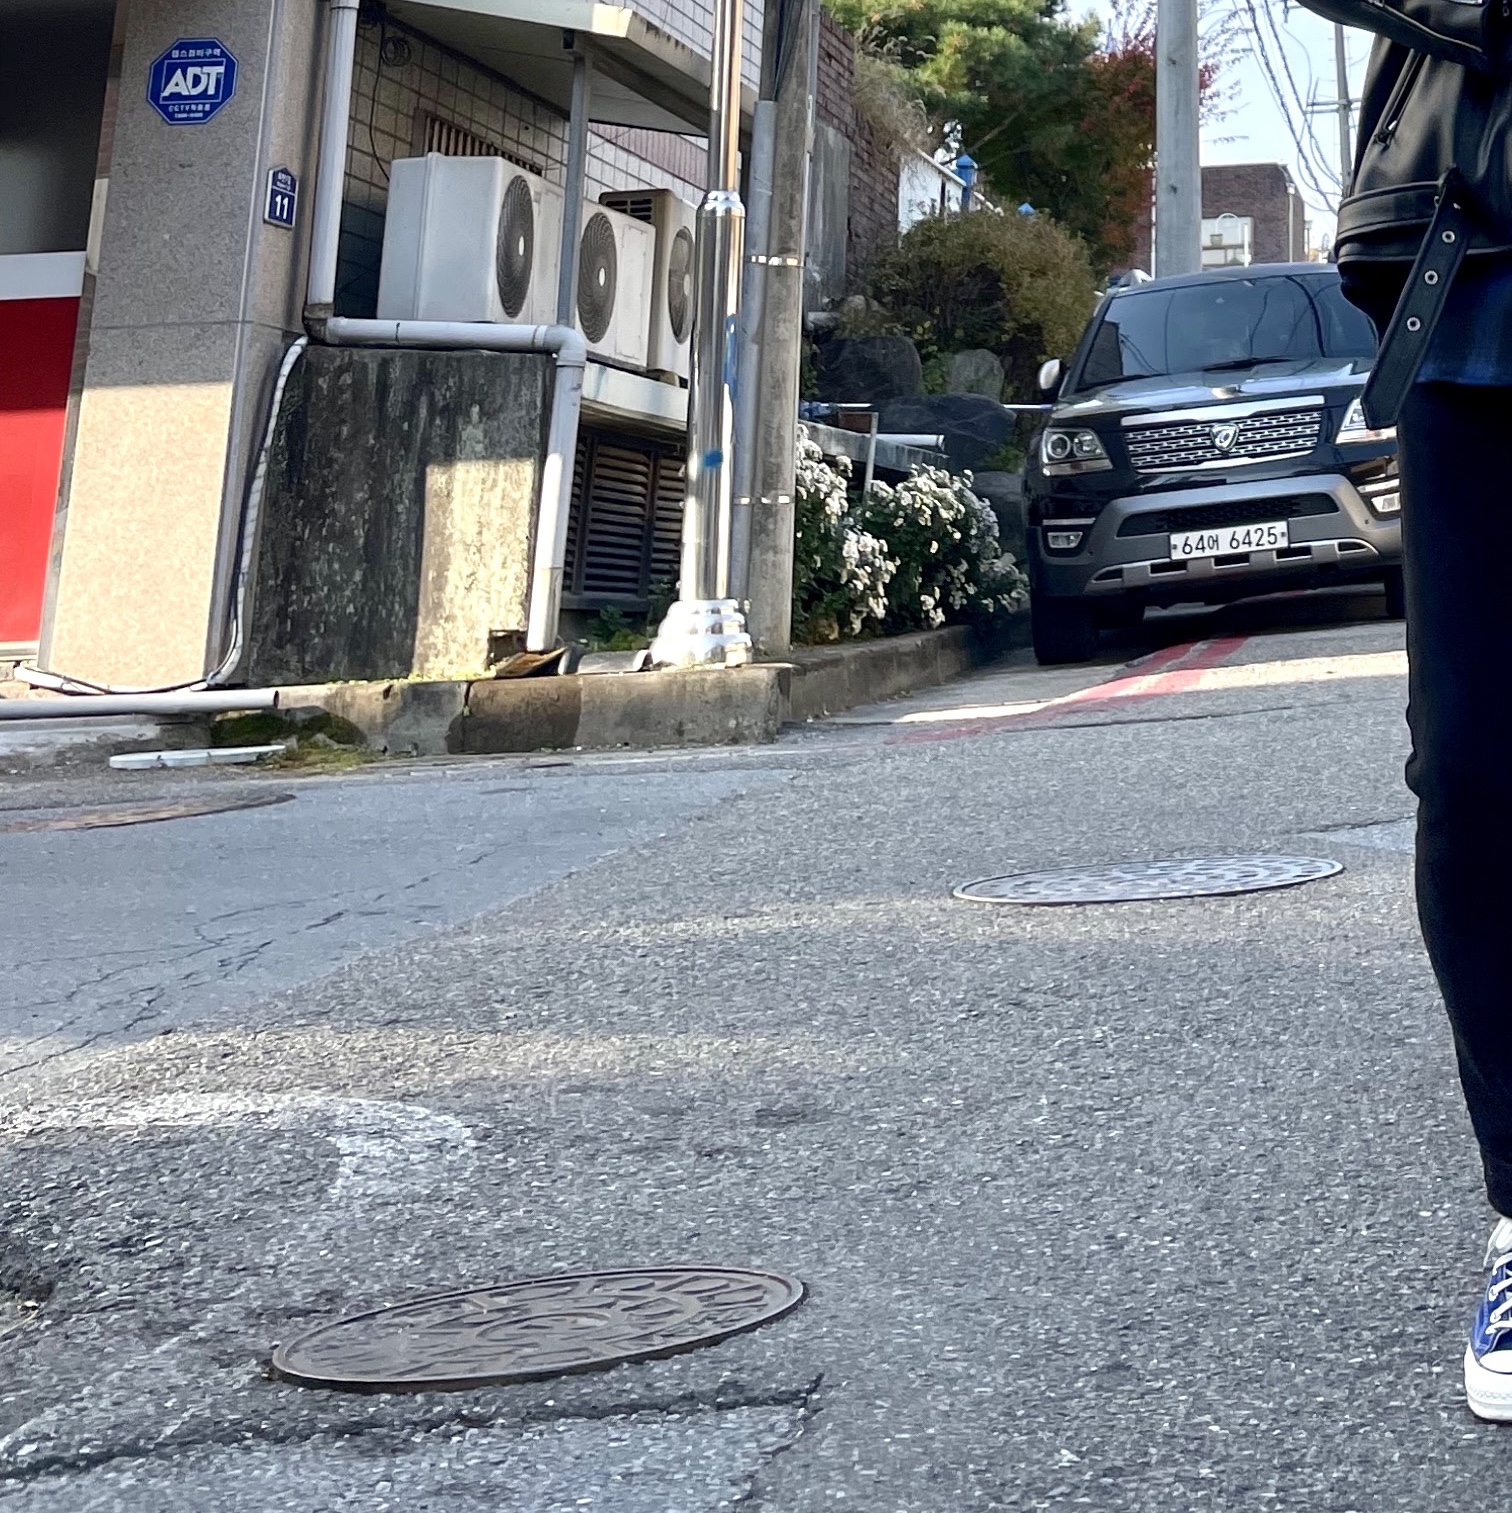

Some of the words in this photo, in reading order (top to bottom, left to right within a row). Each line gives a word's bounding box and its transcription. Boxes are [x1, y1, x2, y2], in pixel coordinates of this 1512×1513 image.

[160, 66, 225, 97] ADT
[275, 194, 289, 220] 11
[1182, 534, 1220, 555] 64어
[1229, 526, 1278, 550] 6425
